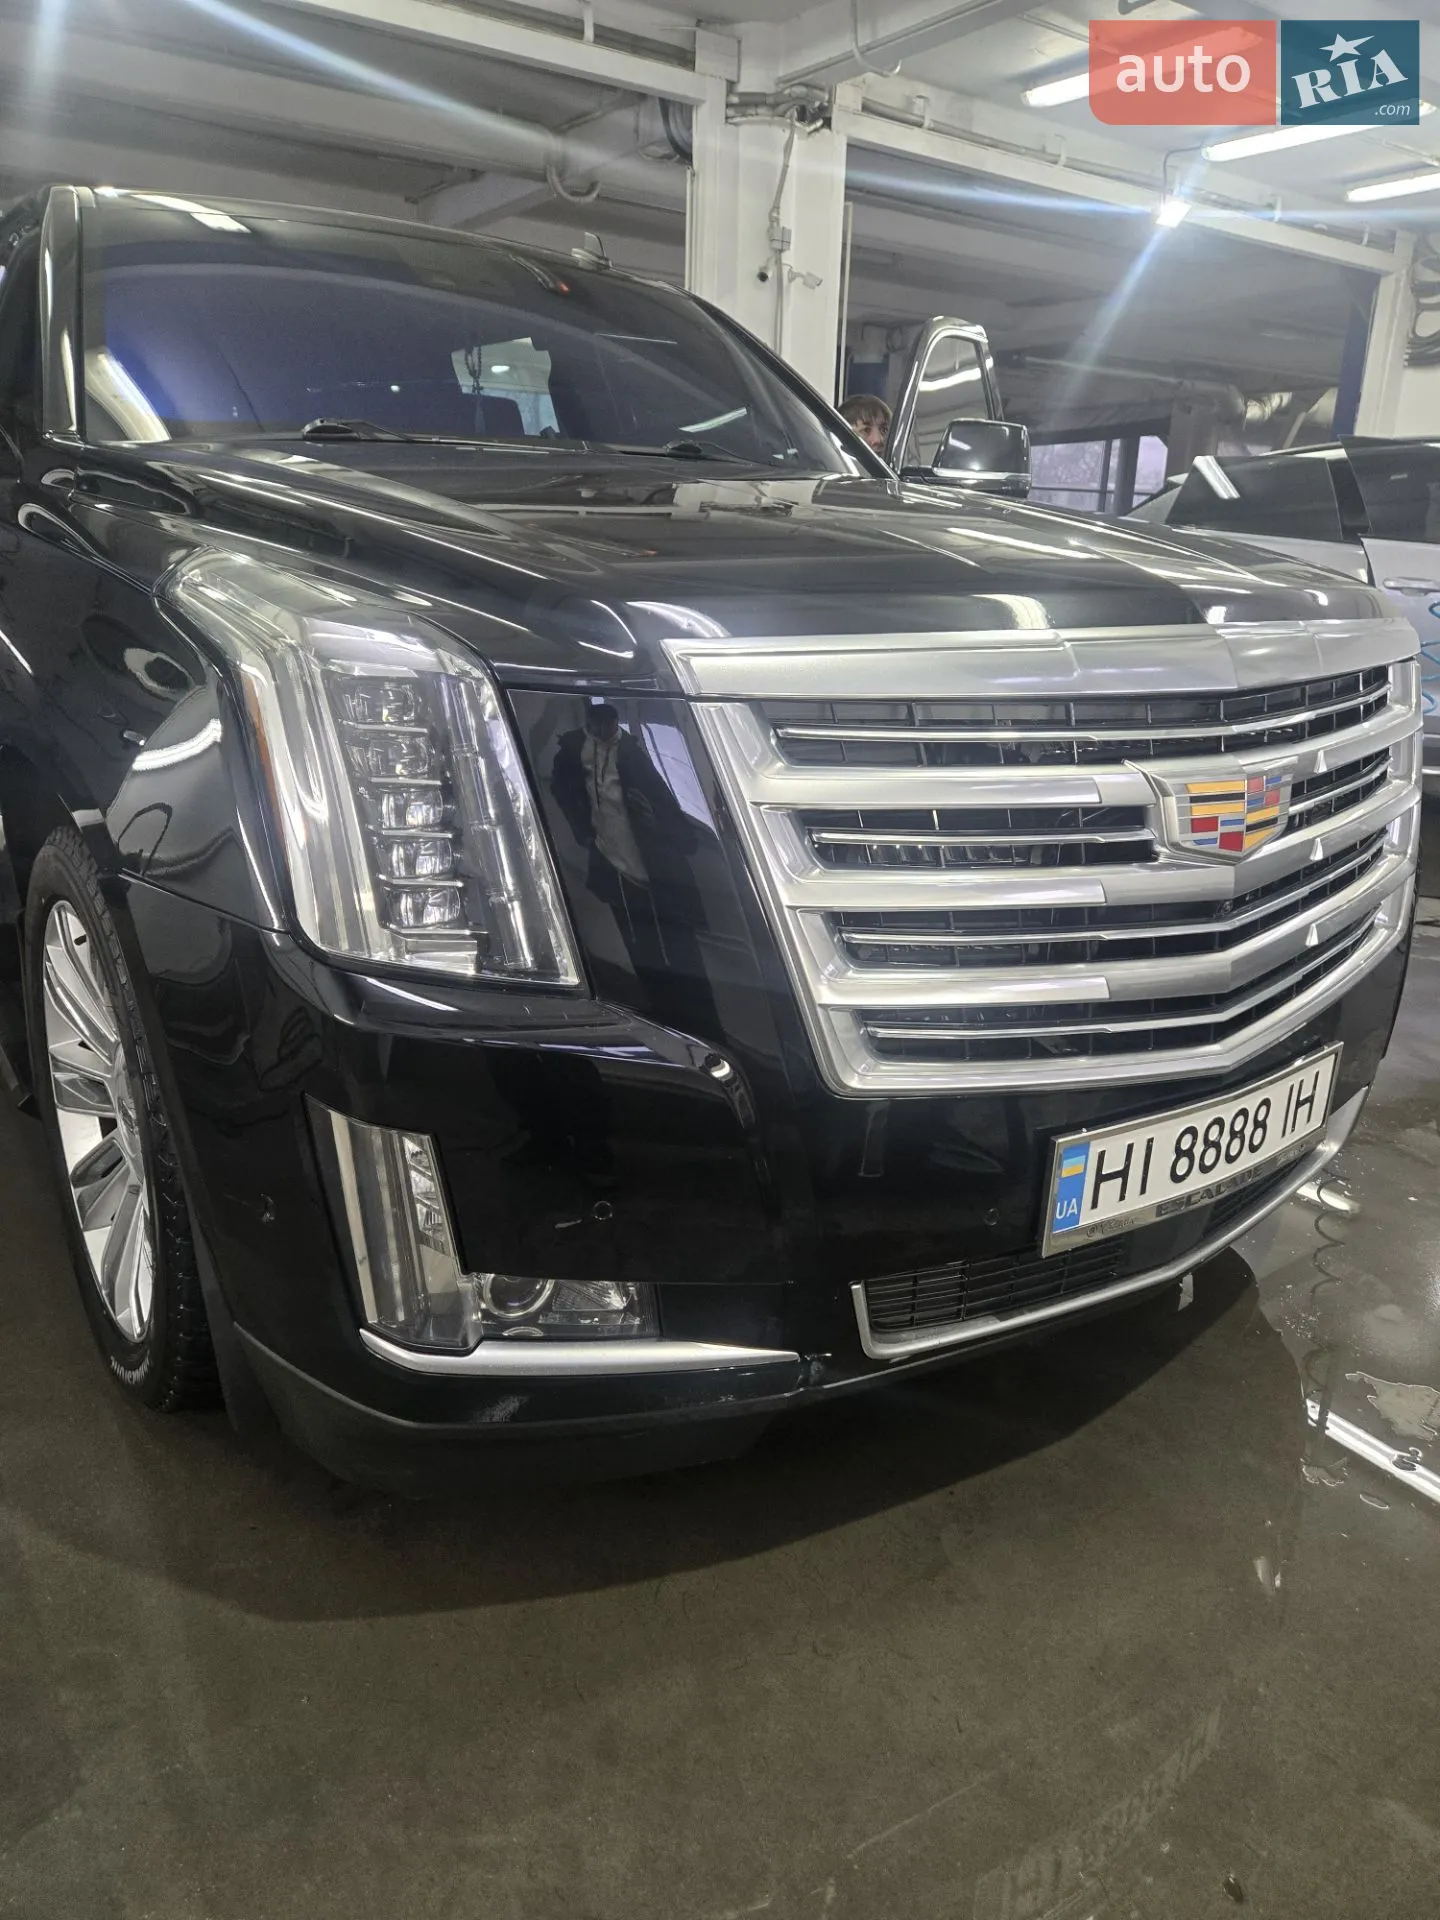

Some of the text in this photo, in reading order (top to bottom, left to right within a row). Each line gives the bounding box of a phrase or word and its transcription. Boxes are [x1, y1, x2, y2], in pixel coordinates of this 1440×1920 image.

[1090, 1070, 1320, 1210] HI 8888 IH
[1055, 1196, 1079, 1220] UA
